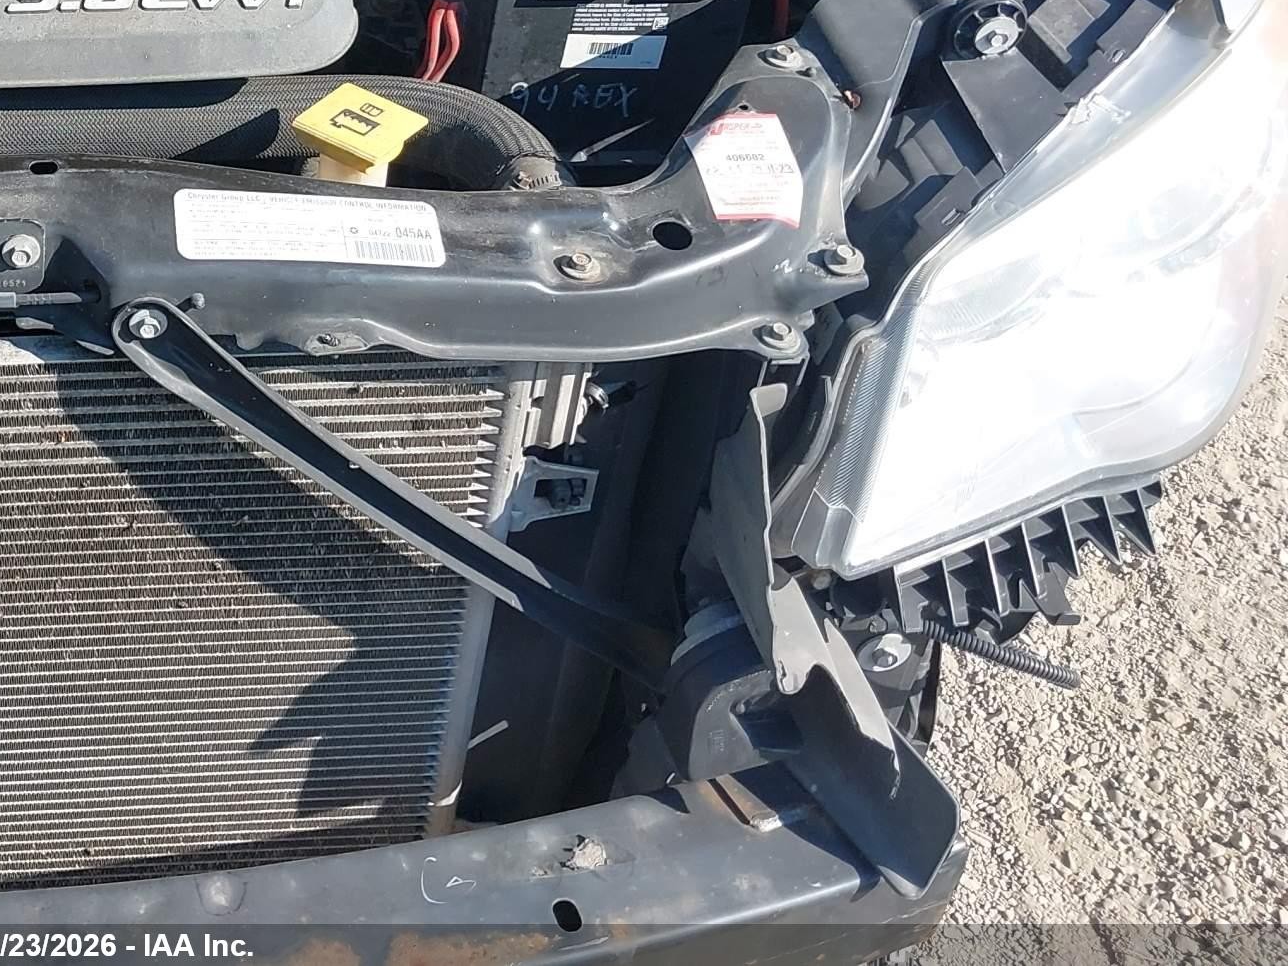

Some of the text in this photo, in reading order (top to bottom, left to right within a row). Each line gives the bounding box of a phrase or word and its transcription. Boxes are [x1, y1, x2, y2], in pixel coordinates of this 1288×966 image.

[221, 193, 244, 203] Group
[246, 194, 261, 202] LLC
[339, 200, 374, 209] CONTROL
[375, 202, 428, 212] INFORMATION
